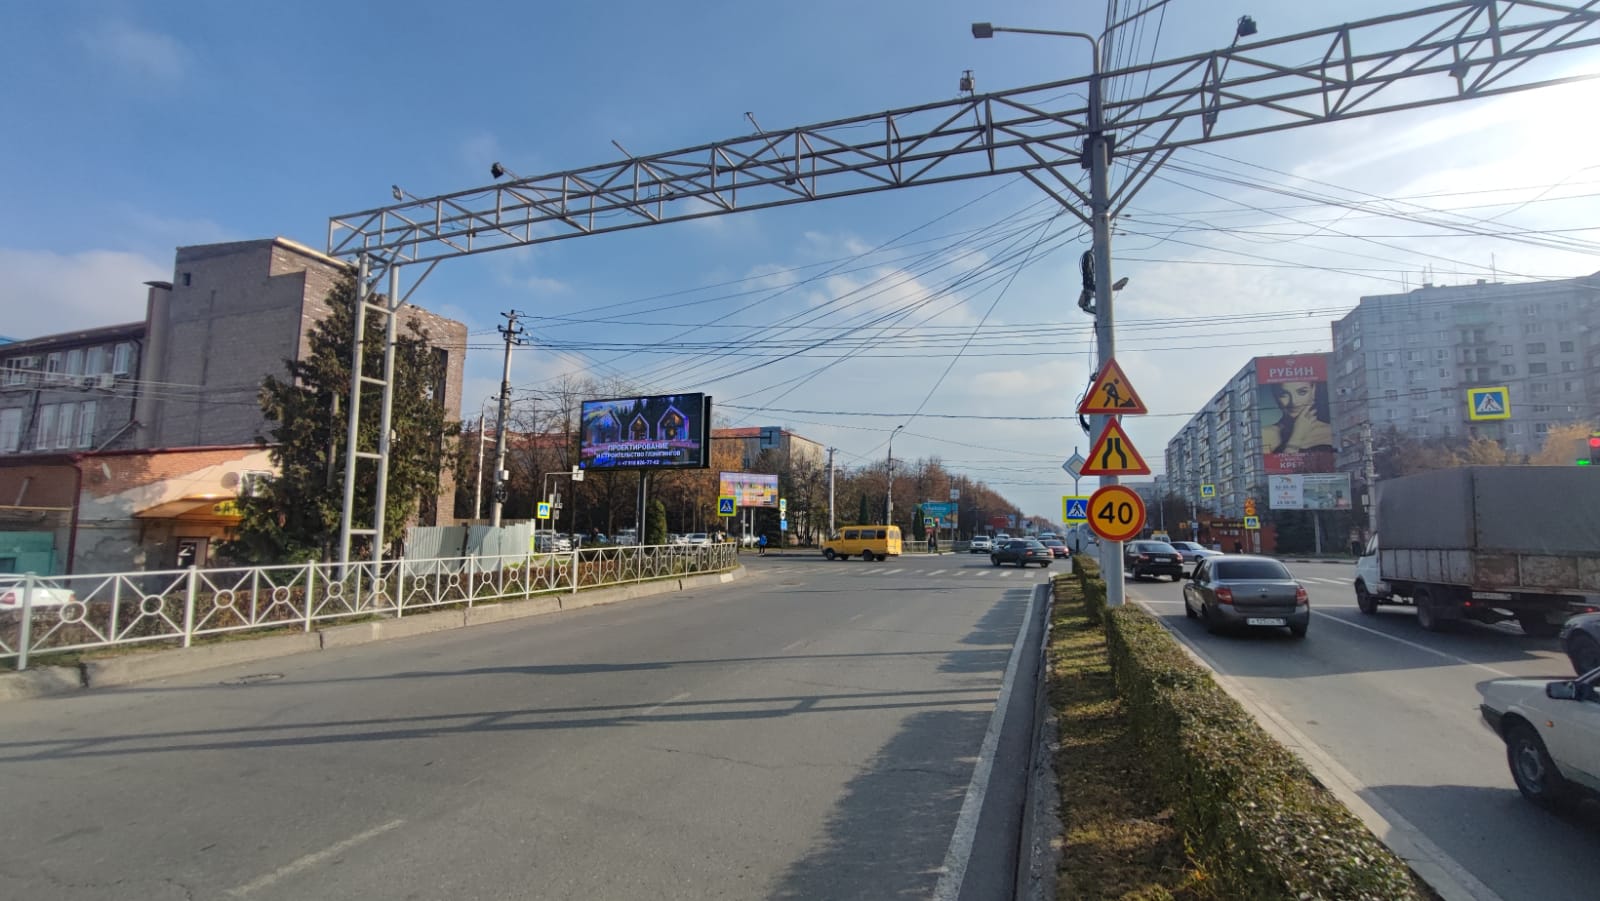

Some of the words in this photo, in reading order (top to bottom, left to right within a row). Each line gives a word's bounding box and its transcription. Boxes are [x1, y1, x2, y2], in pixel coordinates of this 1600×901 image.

[1269, 367, 1314, 377] РУБИН
[608, 442, 669, 452] ПРОЕКТИРОВАНИЕ
[1098, 502, 1133, 524] 40
